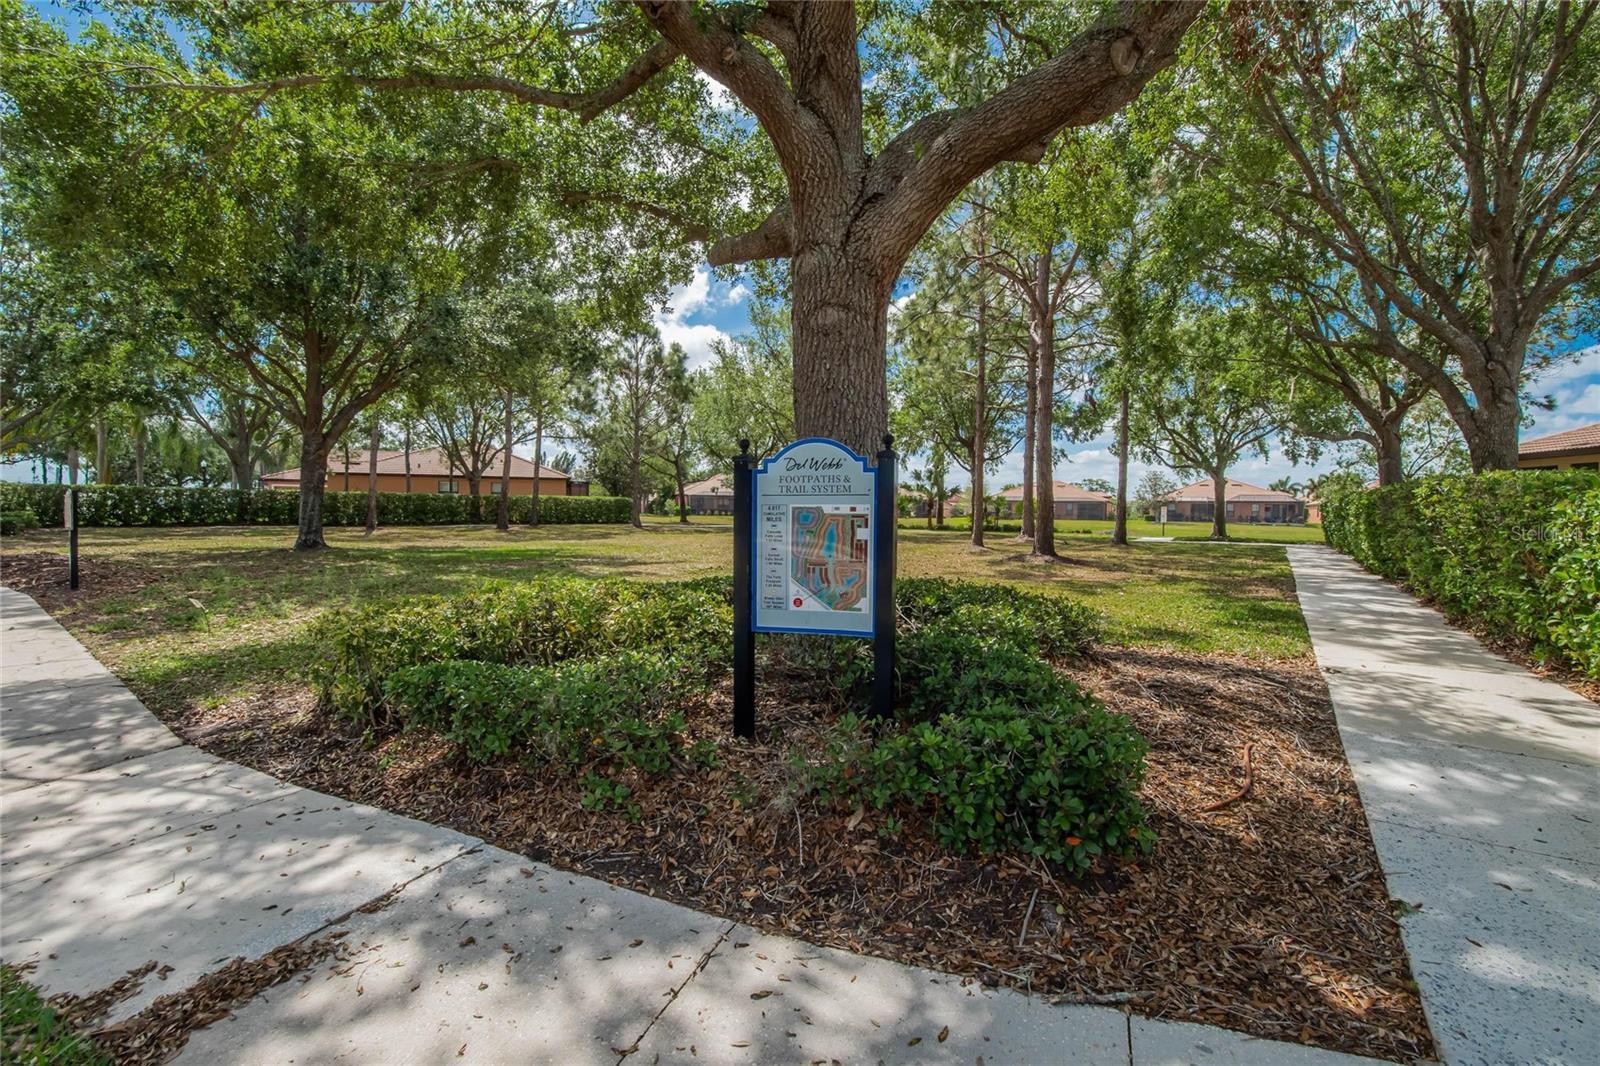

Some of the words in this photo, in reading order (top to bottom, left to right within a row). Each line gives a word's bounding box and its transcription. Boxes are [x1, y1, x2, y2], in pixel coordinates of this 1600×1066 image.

[784, 457, 808, 471] Del
[809, 457, 843, 471] Webb
[779, 474, 841, 484] FOOTPATHS
[843, 474, 852, 484] &
[779, 484, 809, 494] TRAIL
[811, 484, 852, 494] SYSTEM
